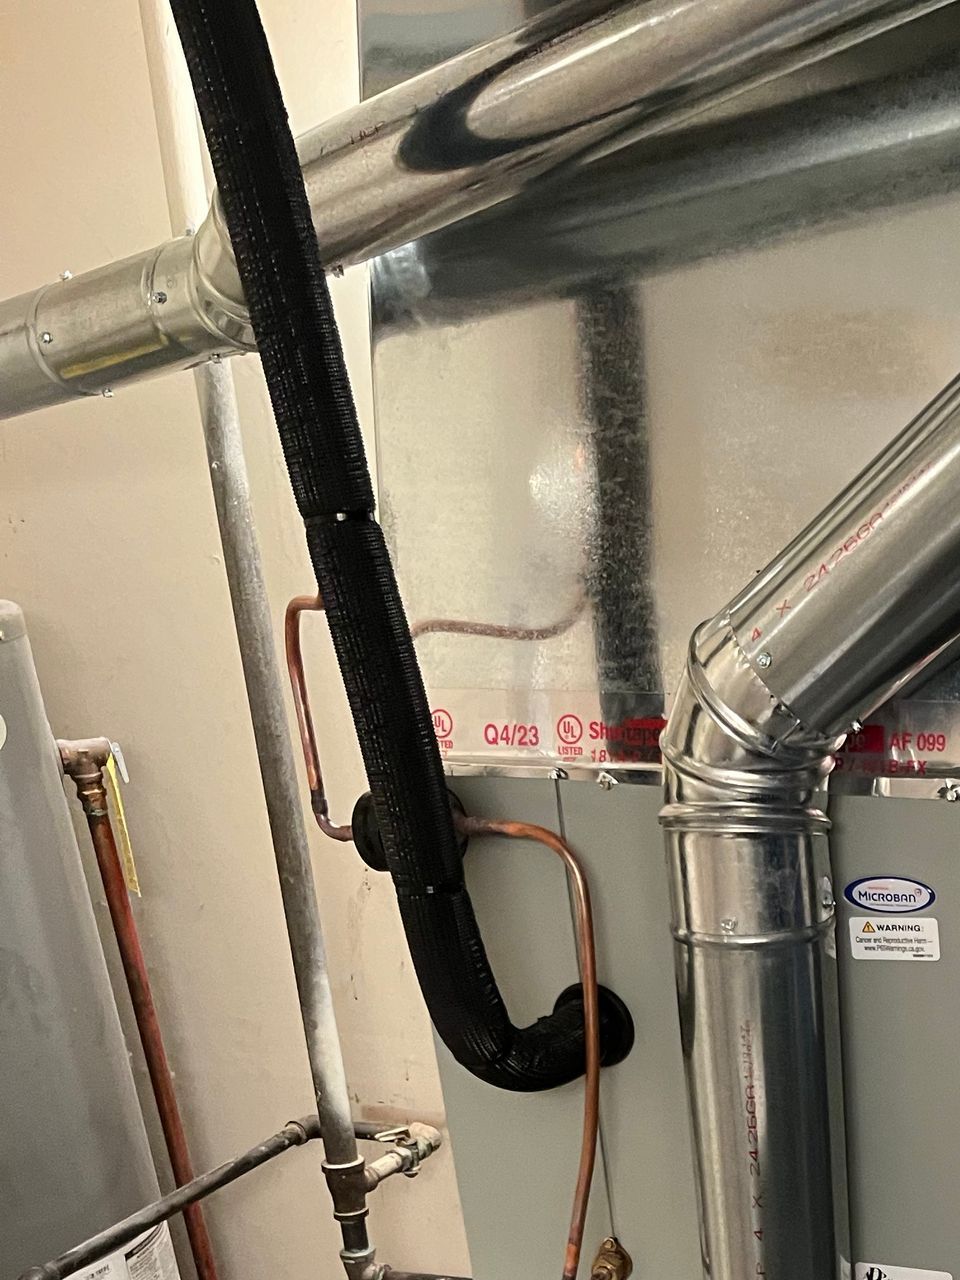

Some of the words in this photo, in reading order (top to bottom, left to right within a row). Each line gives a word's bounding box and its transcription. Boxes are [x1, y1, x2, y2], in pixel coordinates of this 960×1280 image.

[750, 626, 763, 643] 4
[775, 599, 792, 618] X
[483, 722, 540, 747] Q4/23
[890, 732, 913, 752] AF
[916, 733, 946, 752] 099
[557, 746, 584, 756] LISTED
[858, 890, 917, 903] MICROBAN
[748, 1148, 760, 1178] 24
[752, 1195, 765, 1209] X
[753, 1227, 764, 1242] 4
